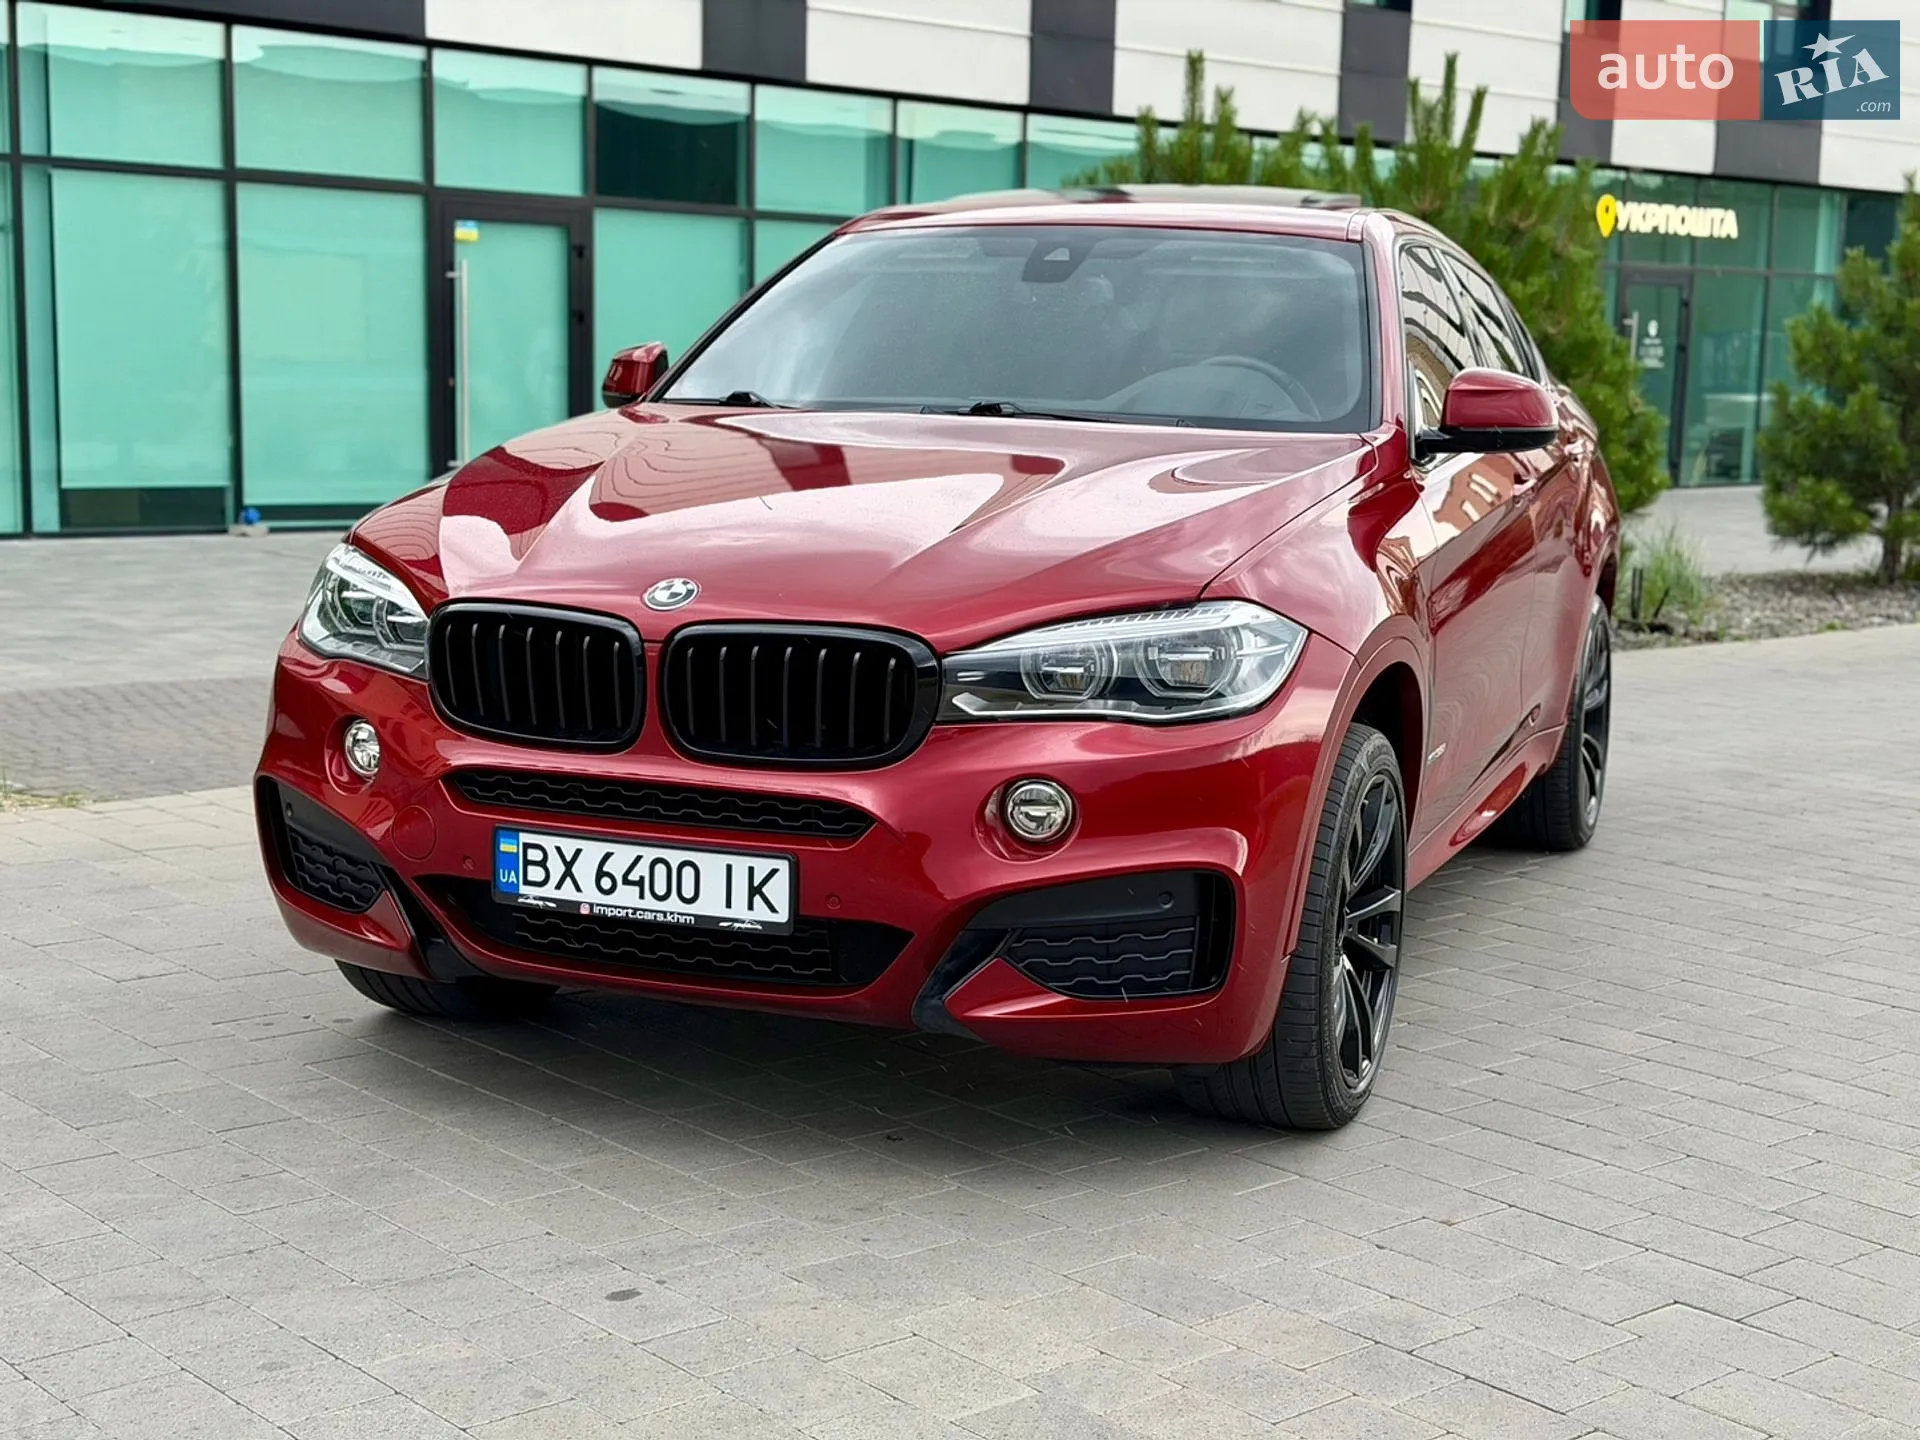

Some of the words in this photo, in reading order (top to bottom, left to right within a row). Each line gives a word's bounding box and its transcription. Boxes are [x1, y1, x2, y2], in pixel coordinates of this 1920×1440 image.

[1615, 200, 1738, 239] УКРПОШТА
[500, 869, 517, 884] UA
[522, 842, 583, 893] BX
[595, 851, 700, 905] 6400
[725, 863, 780, 914] IK
[592, 904, 695, 925] import.cars.khm
